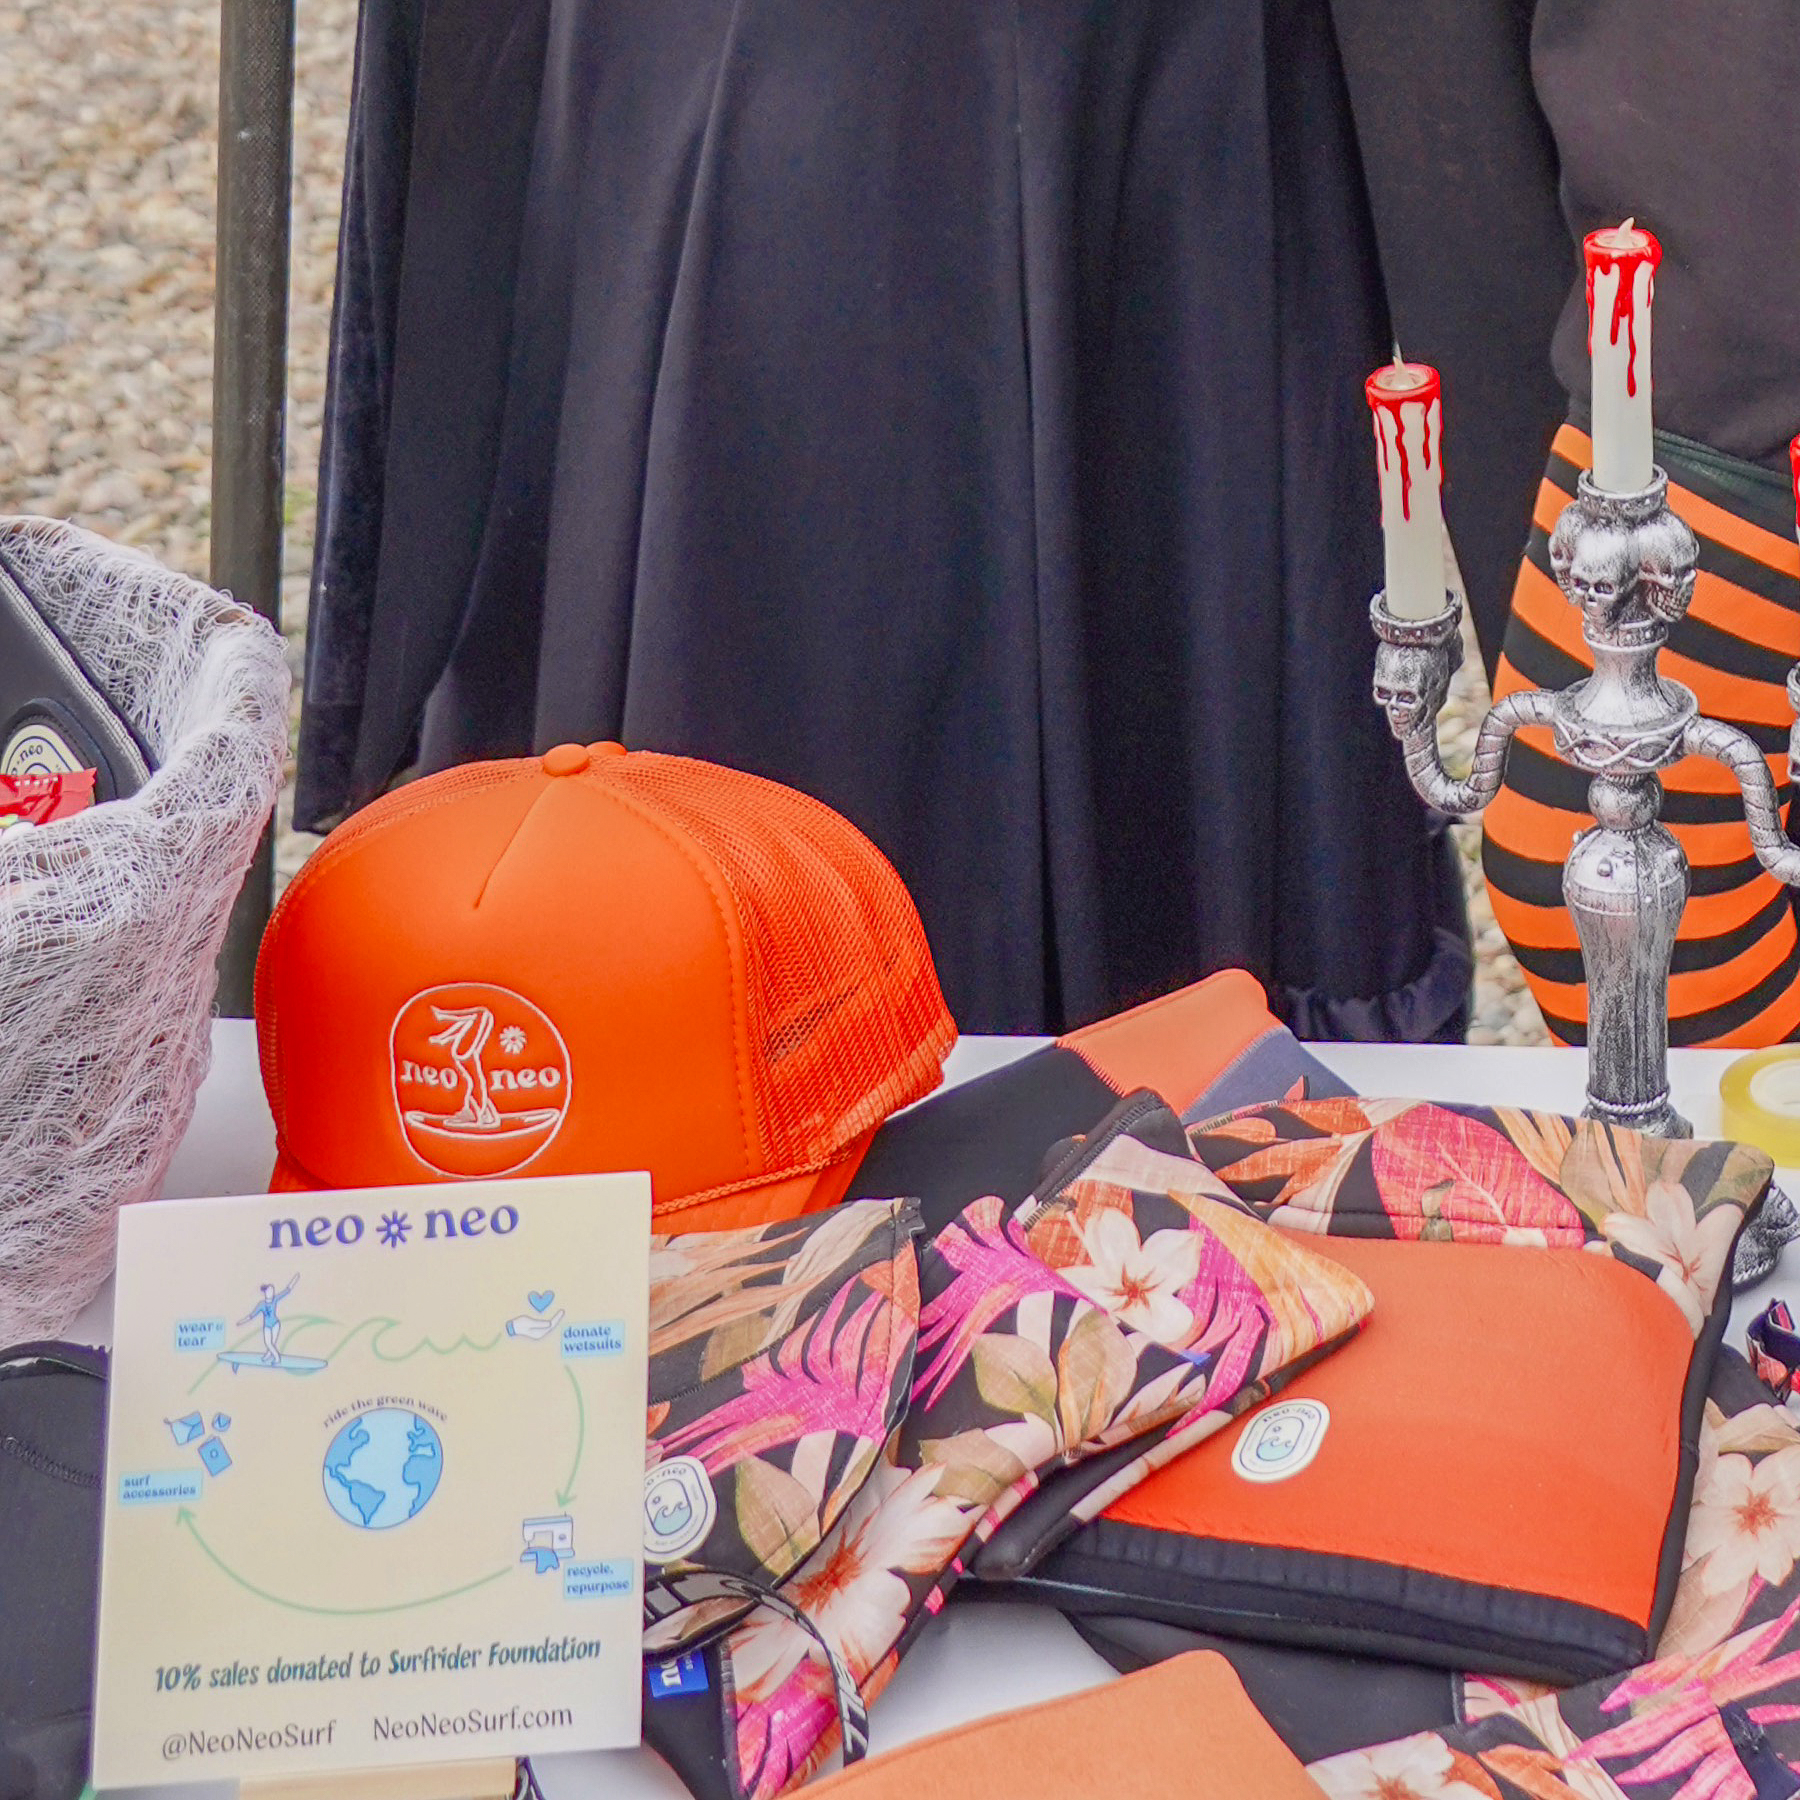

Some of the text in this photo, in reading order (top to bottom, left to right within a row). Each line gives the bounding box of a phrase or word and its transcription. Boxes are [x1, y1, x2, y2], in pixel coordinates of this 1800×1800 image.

[401, 1060, 562, 1091] neo neo
[269, 1204, 520, 1249] neo neo
[178, 1322, 214, 1334] wear
[563, 1325, 612, 1339] donate
[178, 1336, 207, 1348] tear
[563, 1338, 622, 1353] wetsuits
[323, 1395, 448, 1429] ride the green wave
[123, 1474, 151, 1487] surf
[122, 1484, 197, 1500] accessories
[566, 1577, 630, 1595] repurpose
[155, 1635, 602, 1692] 10% sales donated to Surfrider Foundation
[162, 1705, 573, 1761] @NeoNeoSurf NeoNeoSurf.com
